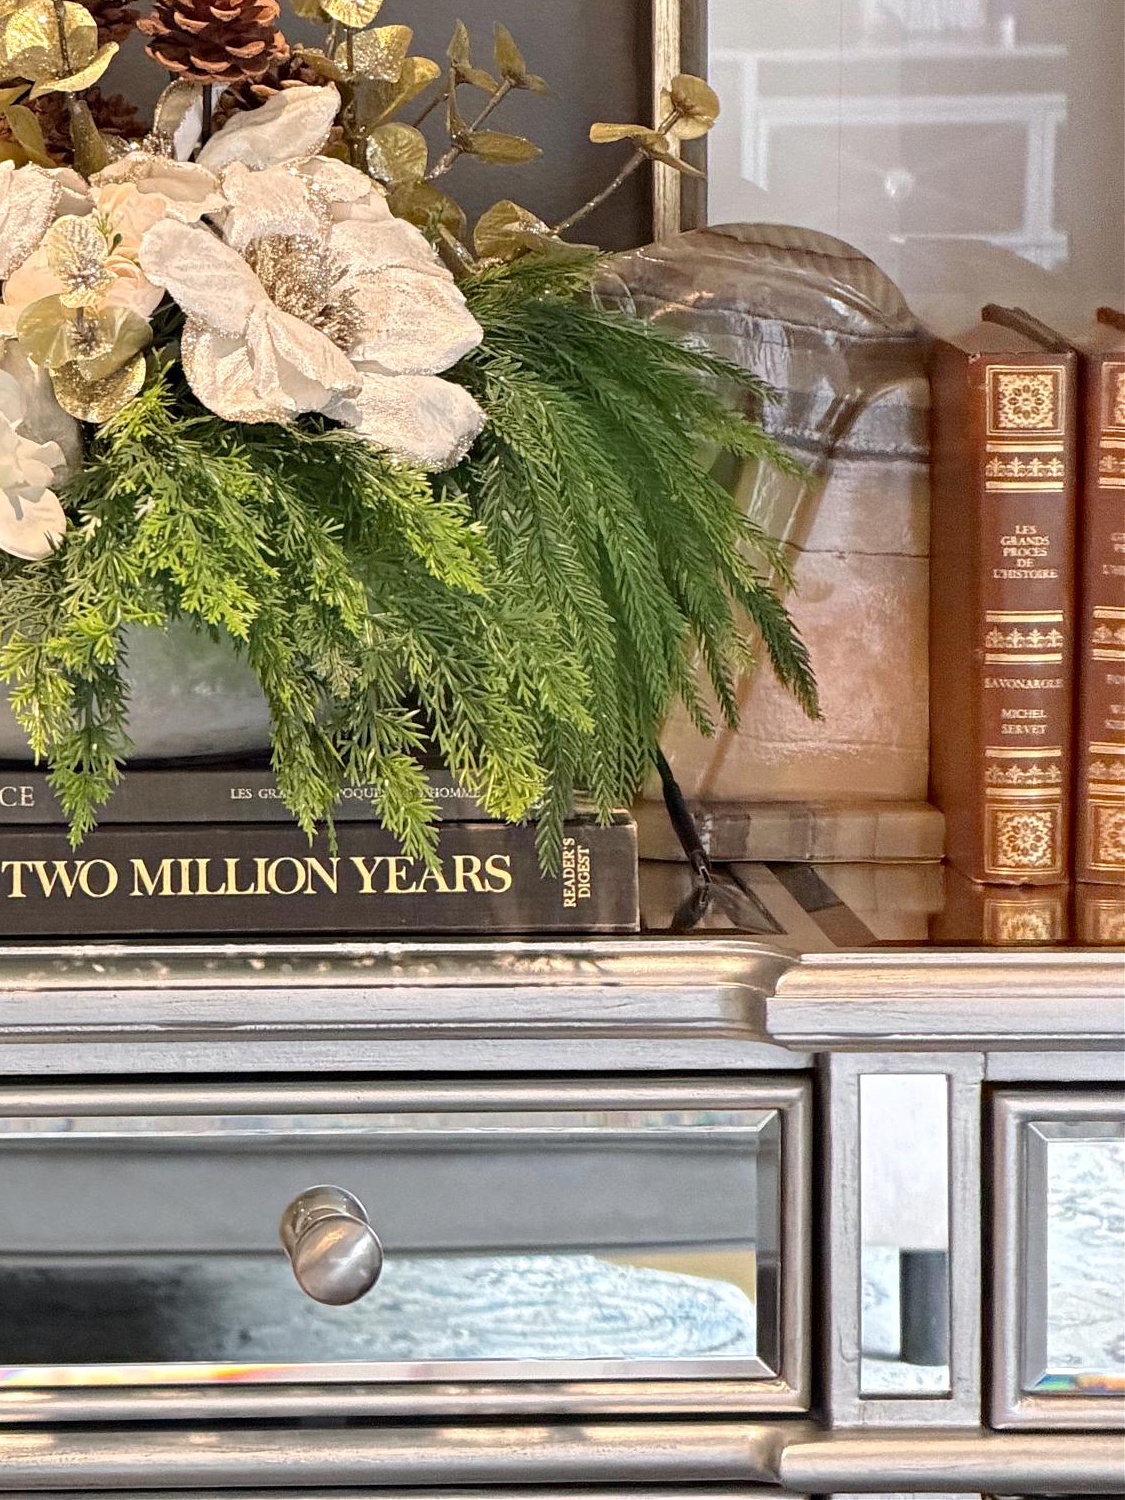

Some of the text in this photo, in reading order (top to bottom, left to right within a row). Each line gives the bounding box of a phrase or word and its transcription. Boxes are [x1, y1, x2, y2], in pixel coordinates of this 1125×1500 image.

[1015, 525, 1037, 534] LES
[1017, 558, 1035, 568] DE
[1001, 709, 1047, 719] MICHEL
[1001, 724, 1047, 735] SERVET
[230, 788, 253, 800] LES
[1, 858, 118, 899] TWO
[128, 856, 342, 898] MILLION
[350, 854, 513, 895] YEARS
[562, 837, 577, 908] READER'S
[577, 845, 591, 899] DIGEST
